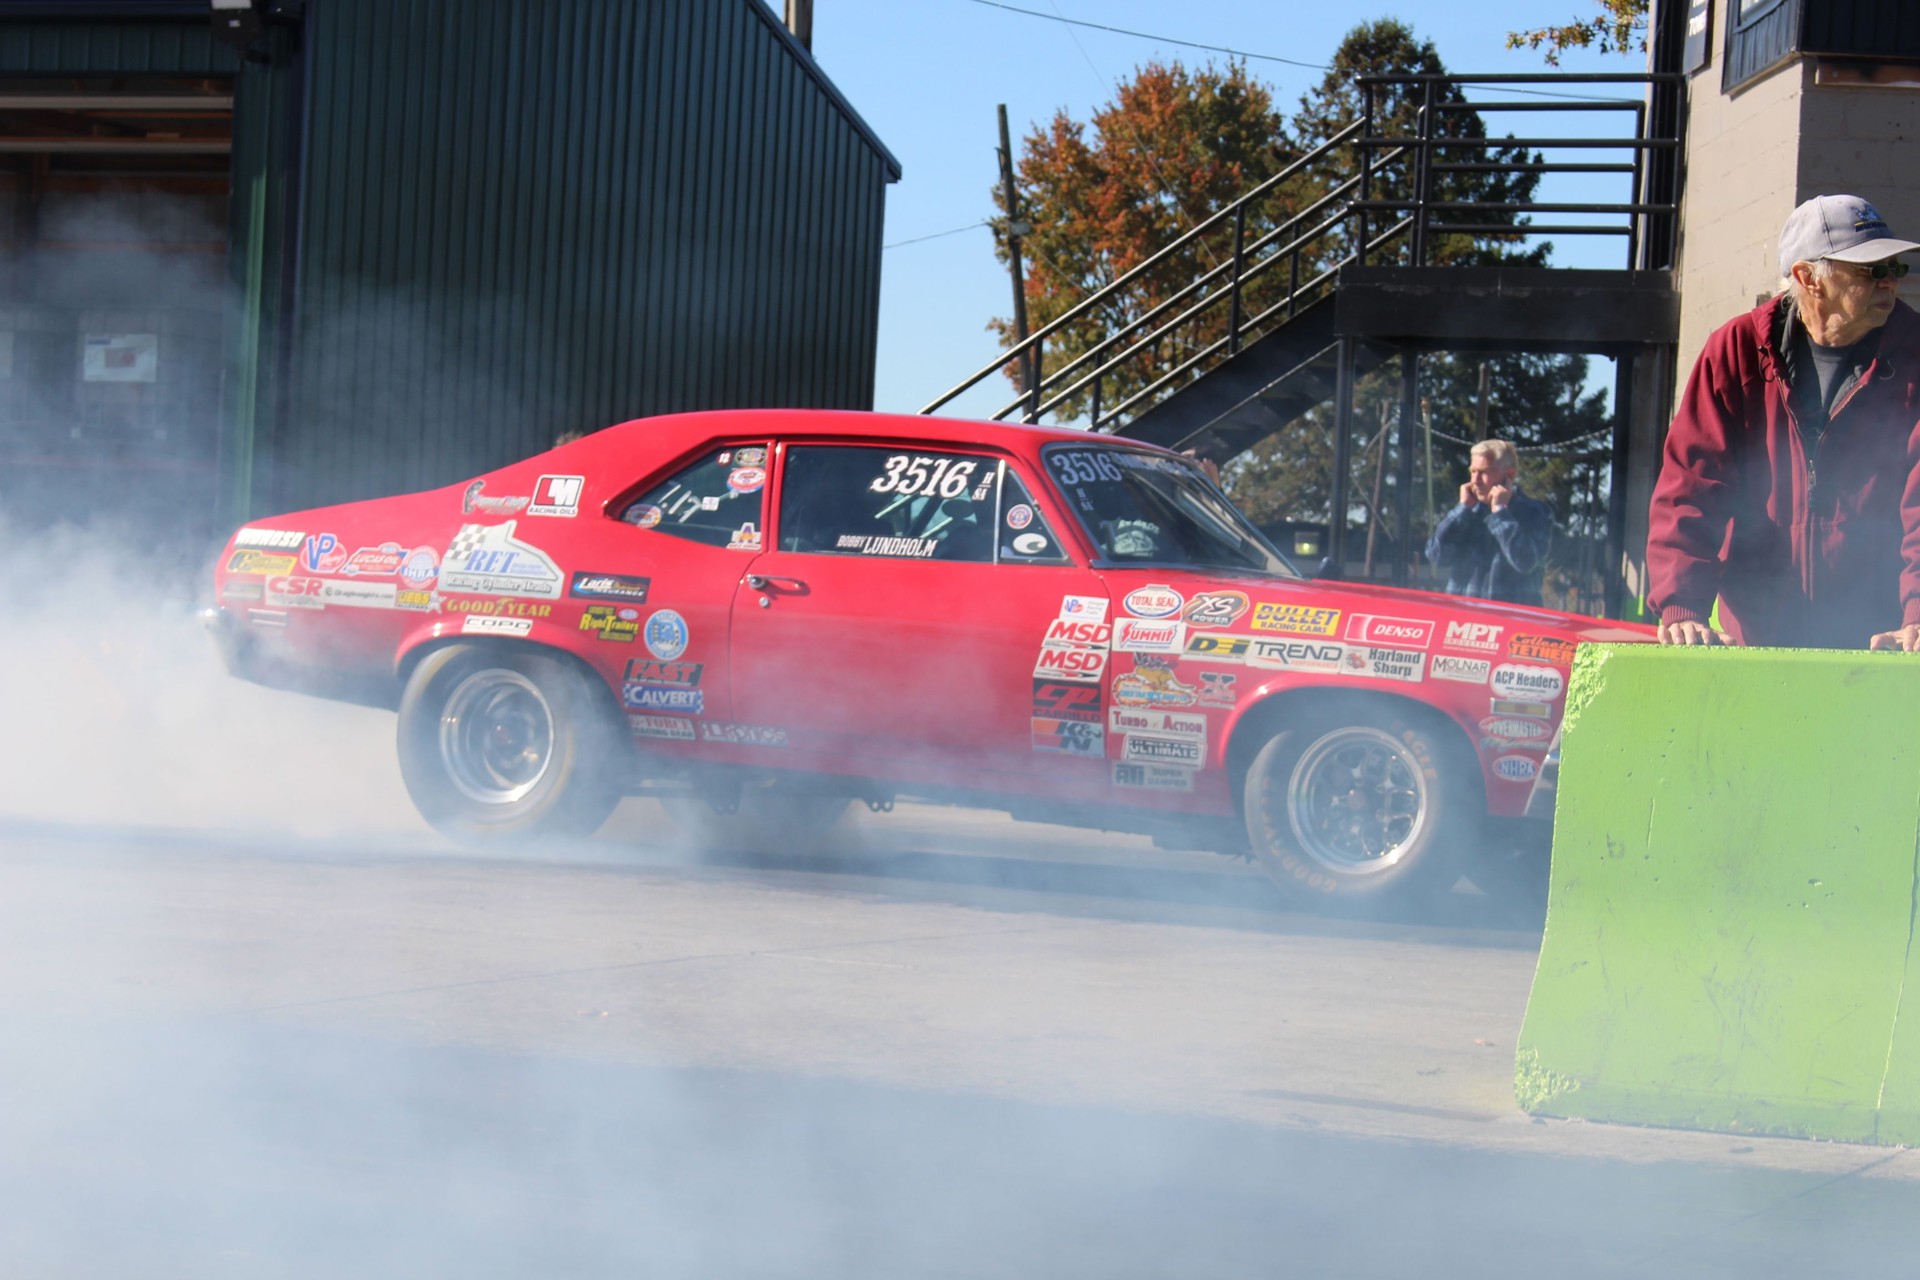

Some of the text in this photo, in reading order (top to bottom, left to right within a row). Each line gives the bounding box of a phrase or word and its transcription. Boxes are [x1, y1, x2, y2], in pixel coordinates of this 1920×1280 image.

[870, 456, 977, 499] 3516
[1051, 452, 1122, 485] 3516
[982, 472, 995, 485] H
[529, 507, 576, 516] RACING OILS
[306, 534, 337, 570] VP
[837, 535, 937, 557] BOBBY LUNDHOLM
[352, 553, 381, 563] LUCAS
[268, 577, 323, 597] CSR
[447, 598, 551, 617] GOODYEAR
[1066, 599, 1079, 614] VP
[1131, 596, 1176, 608] TOTAL SEAL
[1192, 596, 1234, 614] XS
[466, 618, 531, 630] COPO
[1191, 614, 1229, 624] POWER
[1257, 604, 1339, 626] BULLET
[1050, 621, 1111, 643] MSD
[1260, 622, 1328, 634] RACING CAMS
[1373, 624, 1424, 639] DENSO
[1446, 621, 1504, 643] MPT
[1039, 652, 1103, 670] MSD
[1255, 641, 1342, 664] TREND
[1369, 648, 1421, 664] Harland
[631, 663, 696, 681] FAST
[1373, 661, 1412, 677] Sharp
[1433, 656, 1489, 673] MOLNAR
[1495, 671, 1515, 685] ACP
[1515, 673, 1560, 690] Headers
[629, 686, 697, 707] CALVERT
[1499, 761, 1537, 777] NHRA
